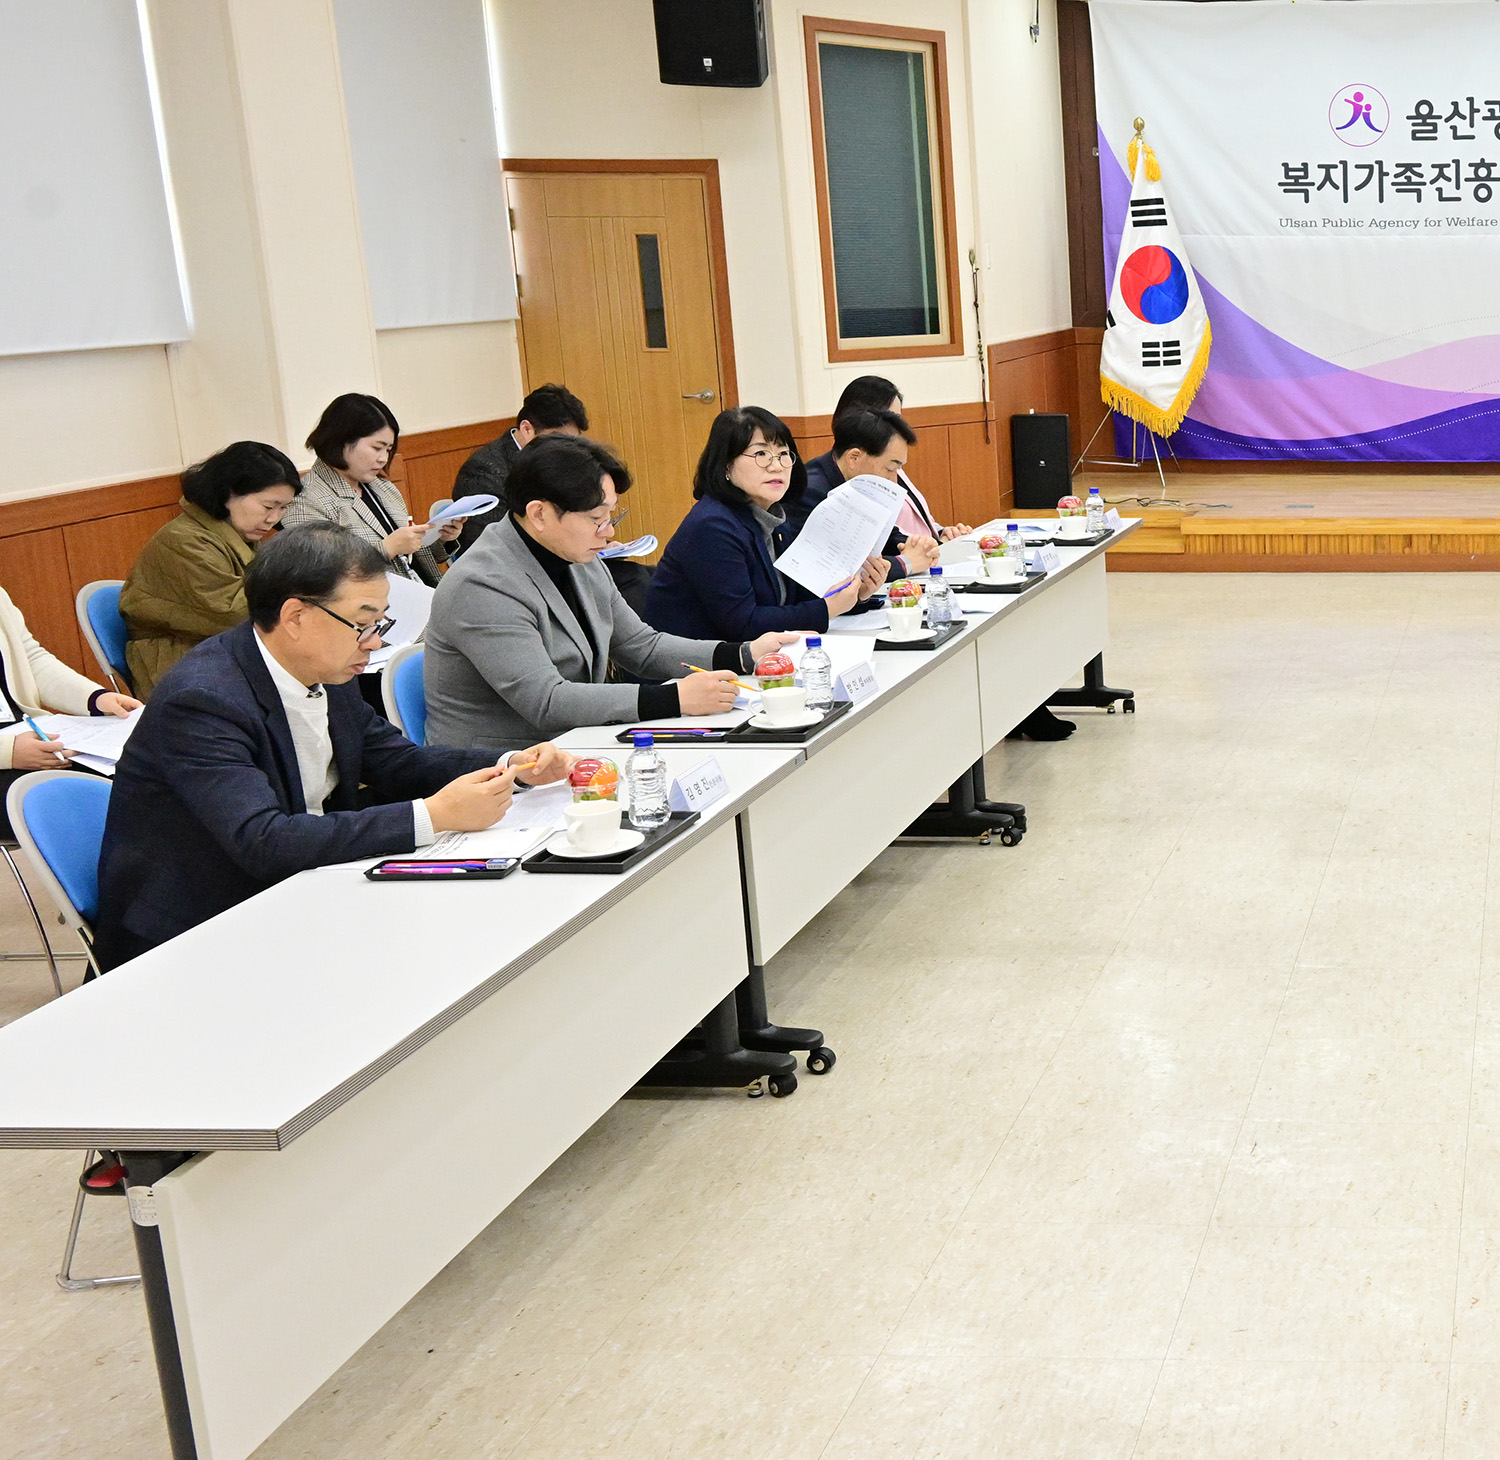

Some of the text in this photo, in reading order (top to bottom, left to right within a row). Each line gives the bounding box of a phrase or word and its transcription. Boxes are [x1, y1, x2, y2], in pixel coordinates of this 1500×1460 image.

[1279, 218, 1318, 228] Ulsan
[1322, 217, 1365, 228] Public
[1368, 218, 1420, 230] Agency
[1424, 217, 1443, 228] for
[1445, 216, 1499, 227] Welfare
